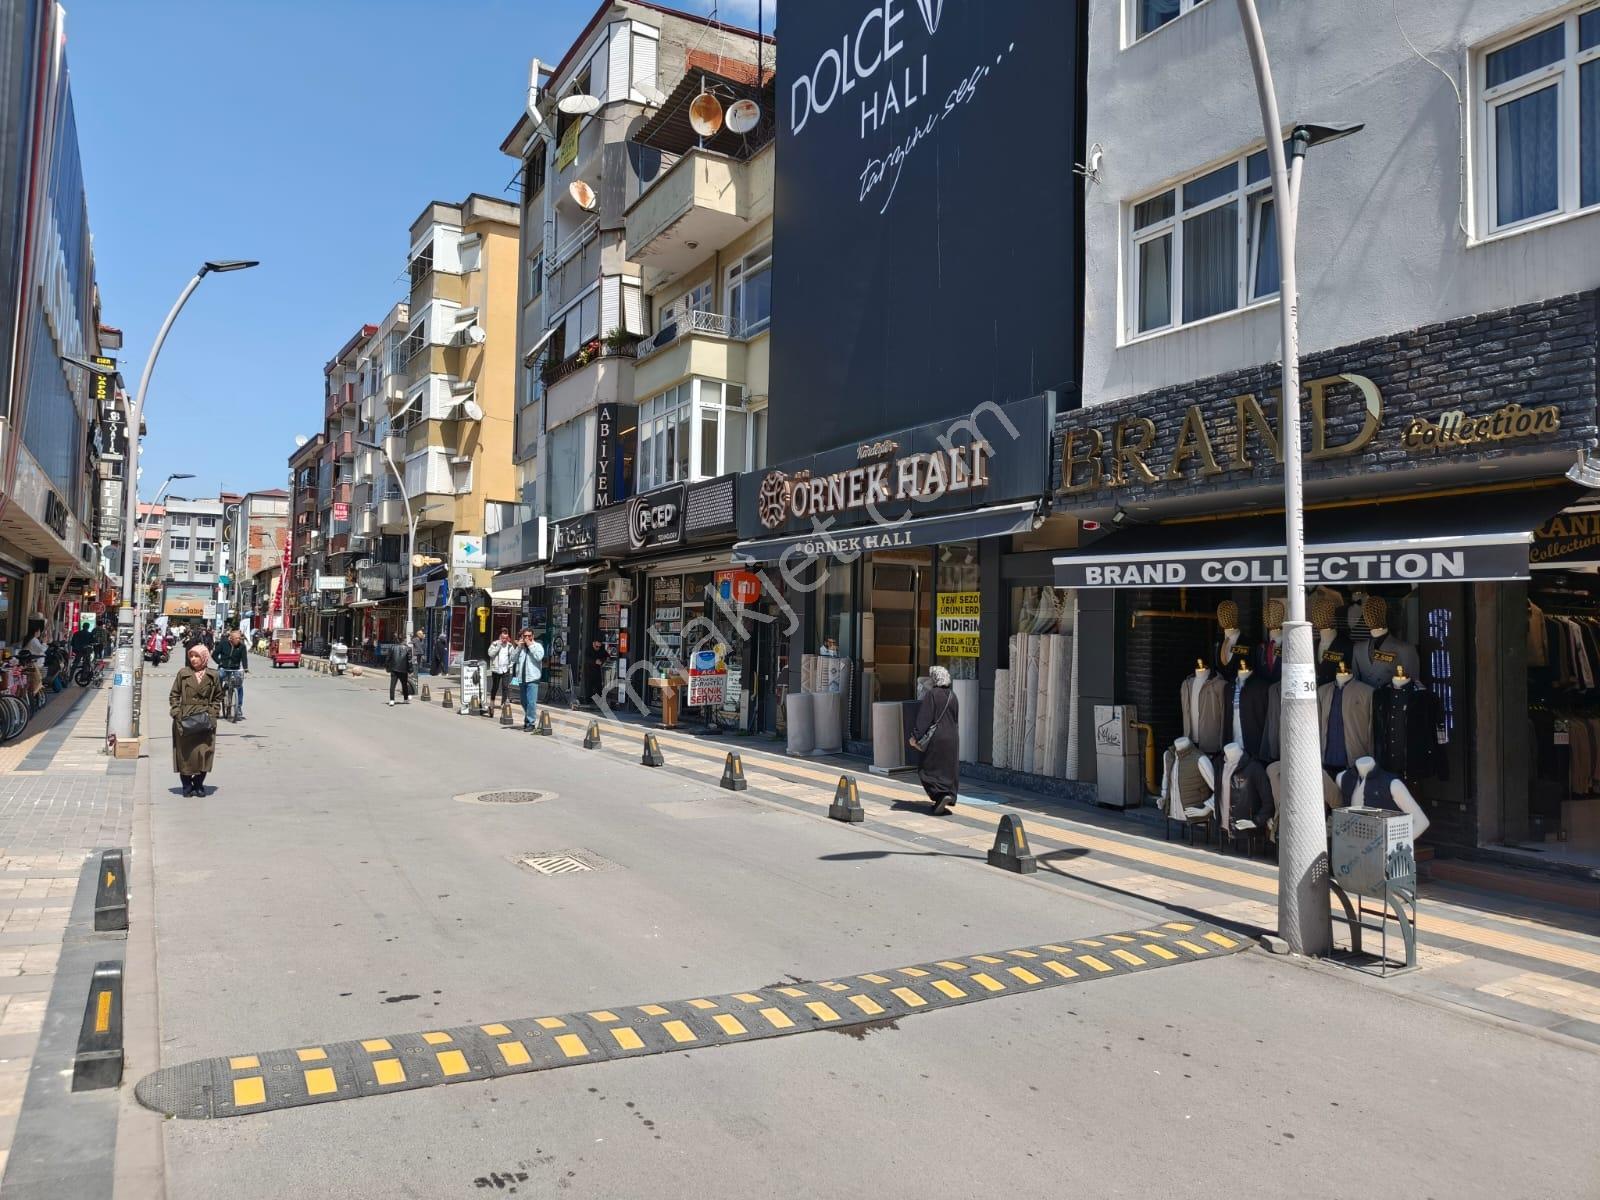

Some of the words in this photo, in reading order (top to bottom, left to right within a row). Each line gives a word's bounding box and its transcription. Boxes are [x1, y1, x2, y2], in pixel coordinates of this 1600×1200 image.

[791, 0, 905, 136] DOLCE
[860, 54, 928, 139] HALI
[1056, 373, 1384, 494] BRAND
[1402, 404, 1560, 450] Collection
[790, 464, 888, 518] ÖRNEK
[896, 441, 989, 500] HALI
[804, 536, 861, 555] ÖRNEK
[865, 531, 912, 549] HALI
[1085, 562, 1187, 586] BRAND
[940, 605, 980, 615] ÜRÜNLERD
[960, 595, 981, 604] SEZO
